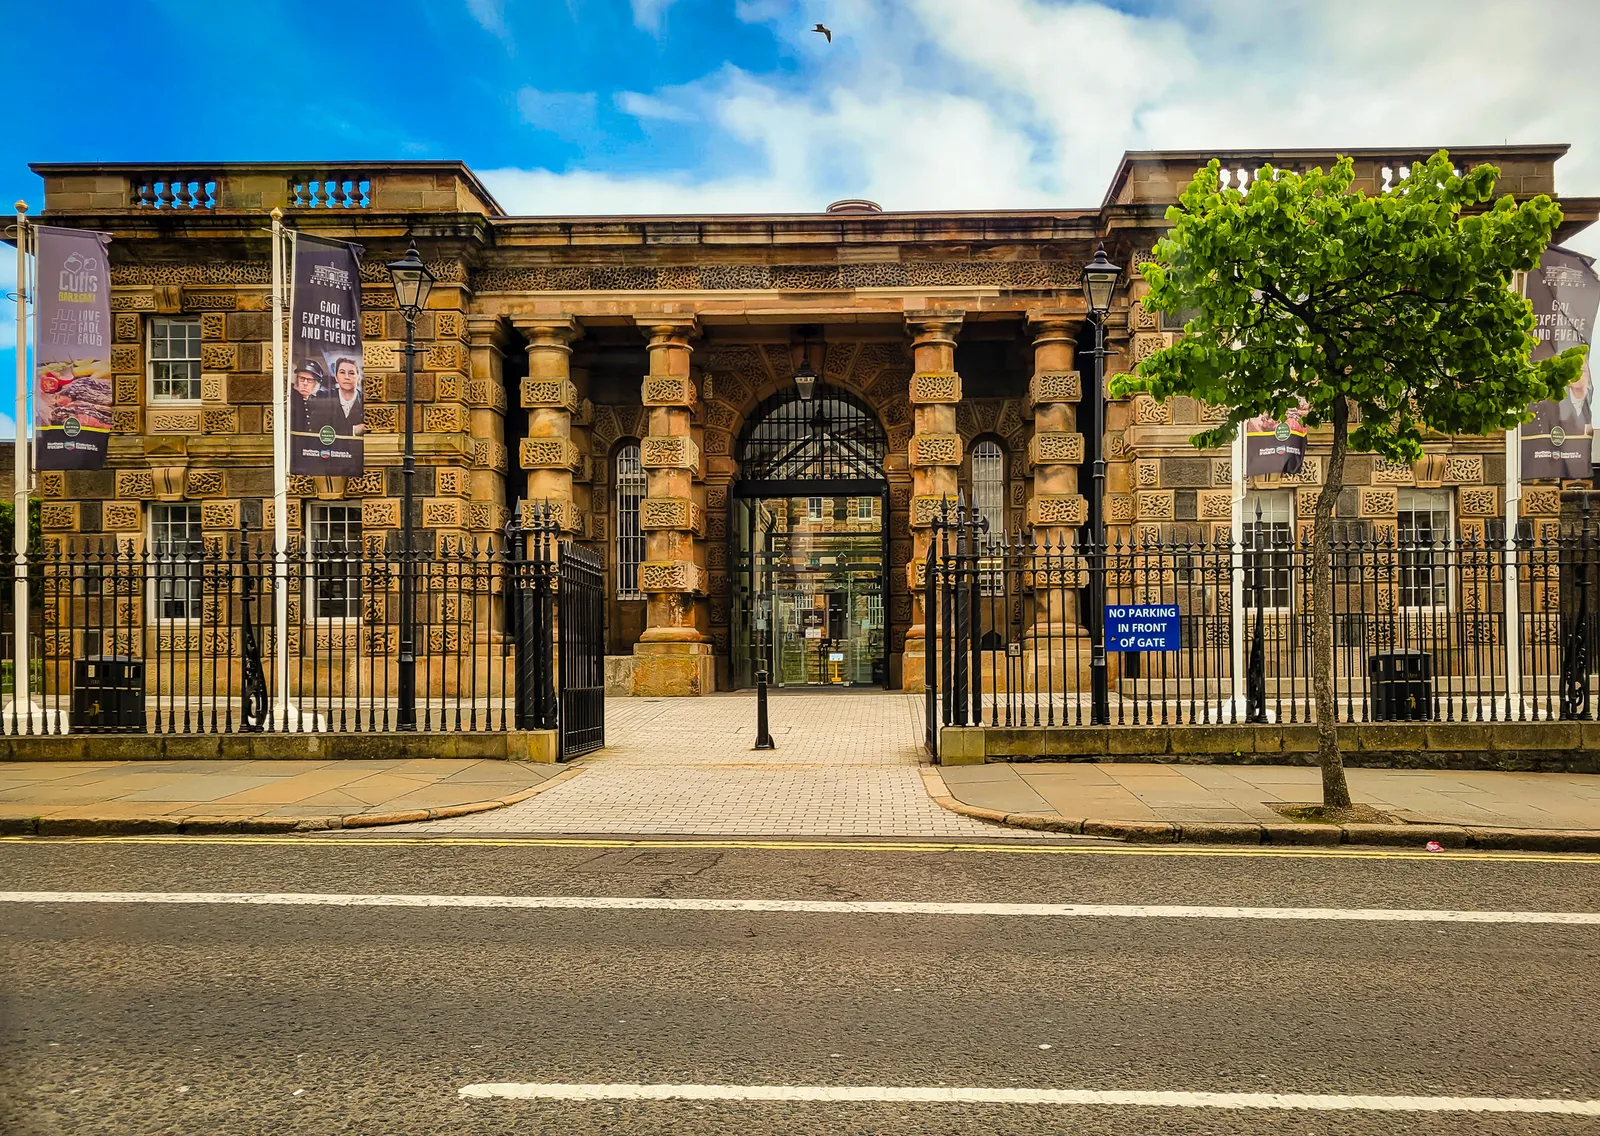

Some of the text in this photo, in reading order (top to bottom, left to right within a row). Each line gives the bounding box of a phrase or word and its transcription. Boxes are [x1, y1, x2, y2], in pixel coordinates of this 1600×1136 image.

[59, 271, 98, 293] Cuffs
[310, 279, 352, 291] BELFAST
[1542, 280, 1586, 288] BELFAST
[58, 291, 96, 303] BAR&GR
[320, 300, 342, 316] GAOL
[1551, 299, 1570, 315] GOL
[79, 309, 101, 322] LOVE
[302, 311, 356, 332] EXPERIENCE
[1534, 313, 1586, 330] EXPERINCE
[78, 321, 101, 334] GAOL
[77, 333, 102, 346] GRUB
[301, 326, 356, 346] AND EVENTS
[1532, 328, 1586, 344] AND EVEN
[1109, 608, 1176, 618] NO PARKING
[1118, 623, 1167, 633] IN FRONT
[1120, 638, 1166, 648] OF GATE
